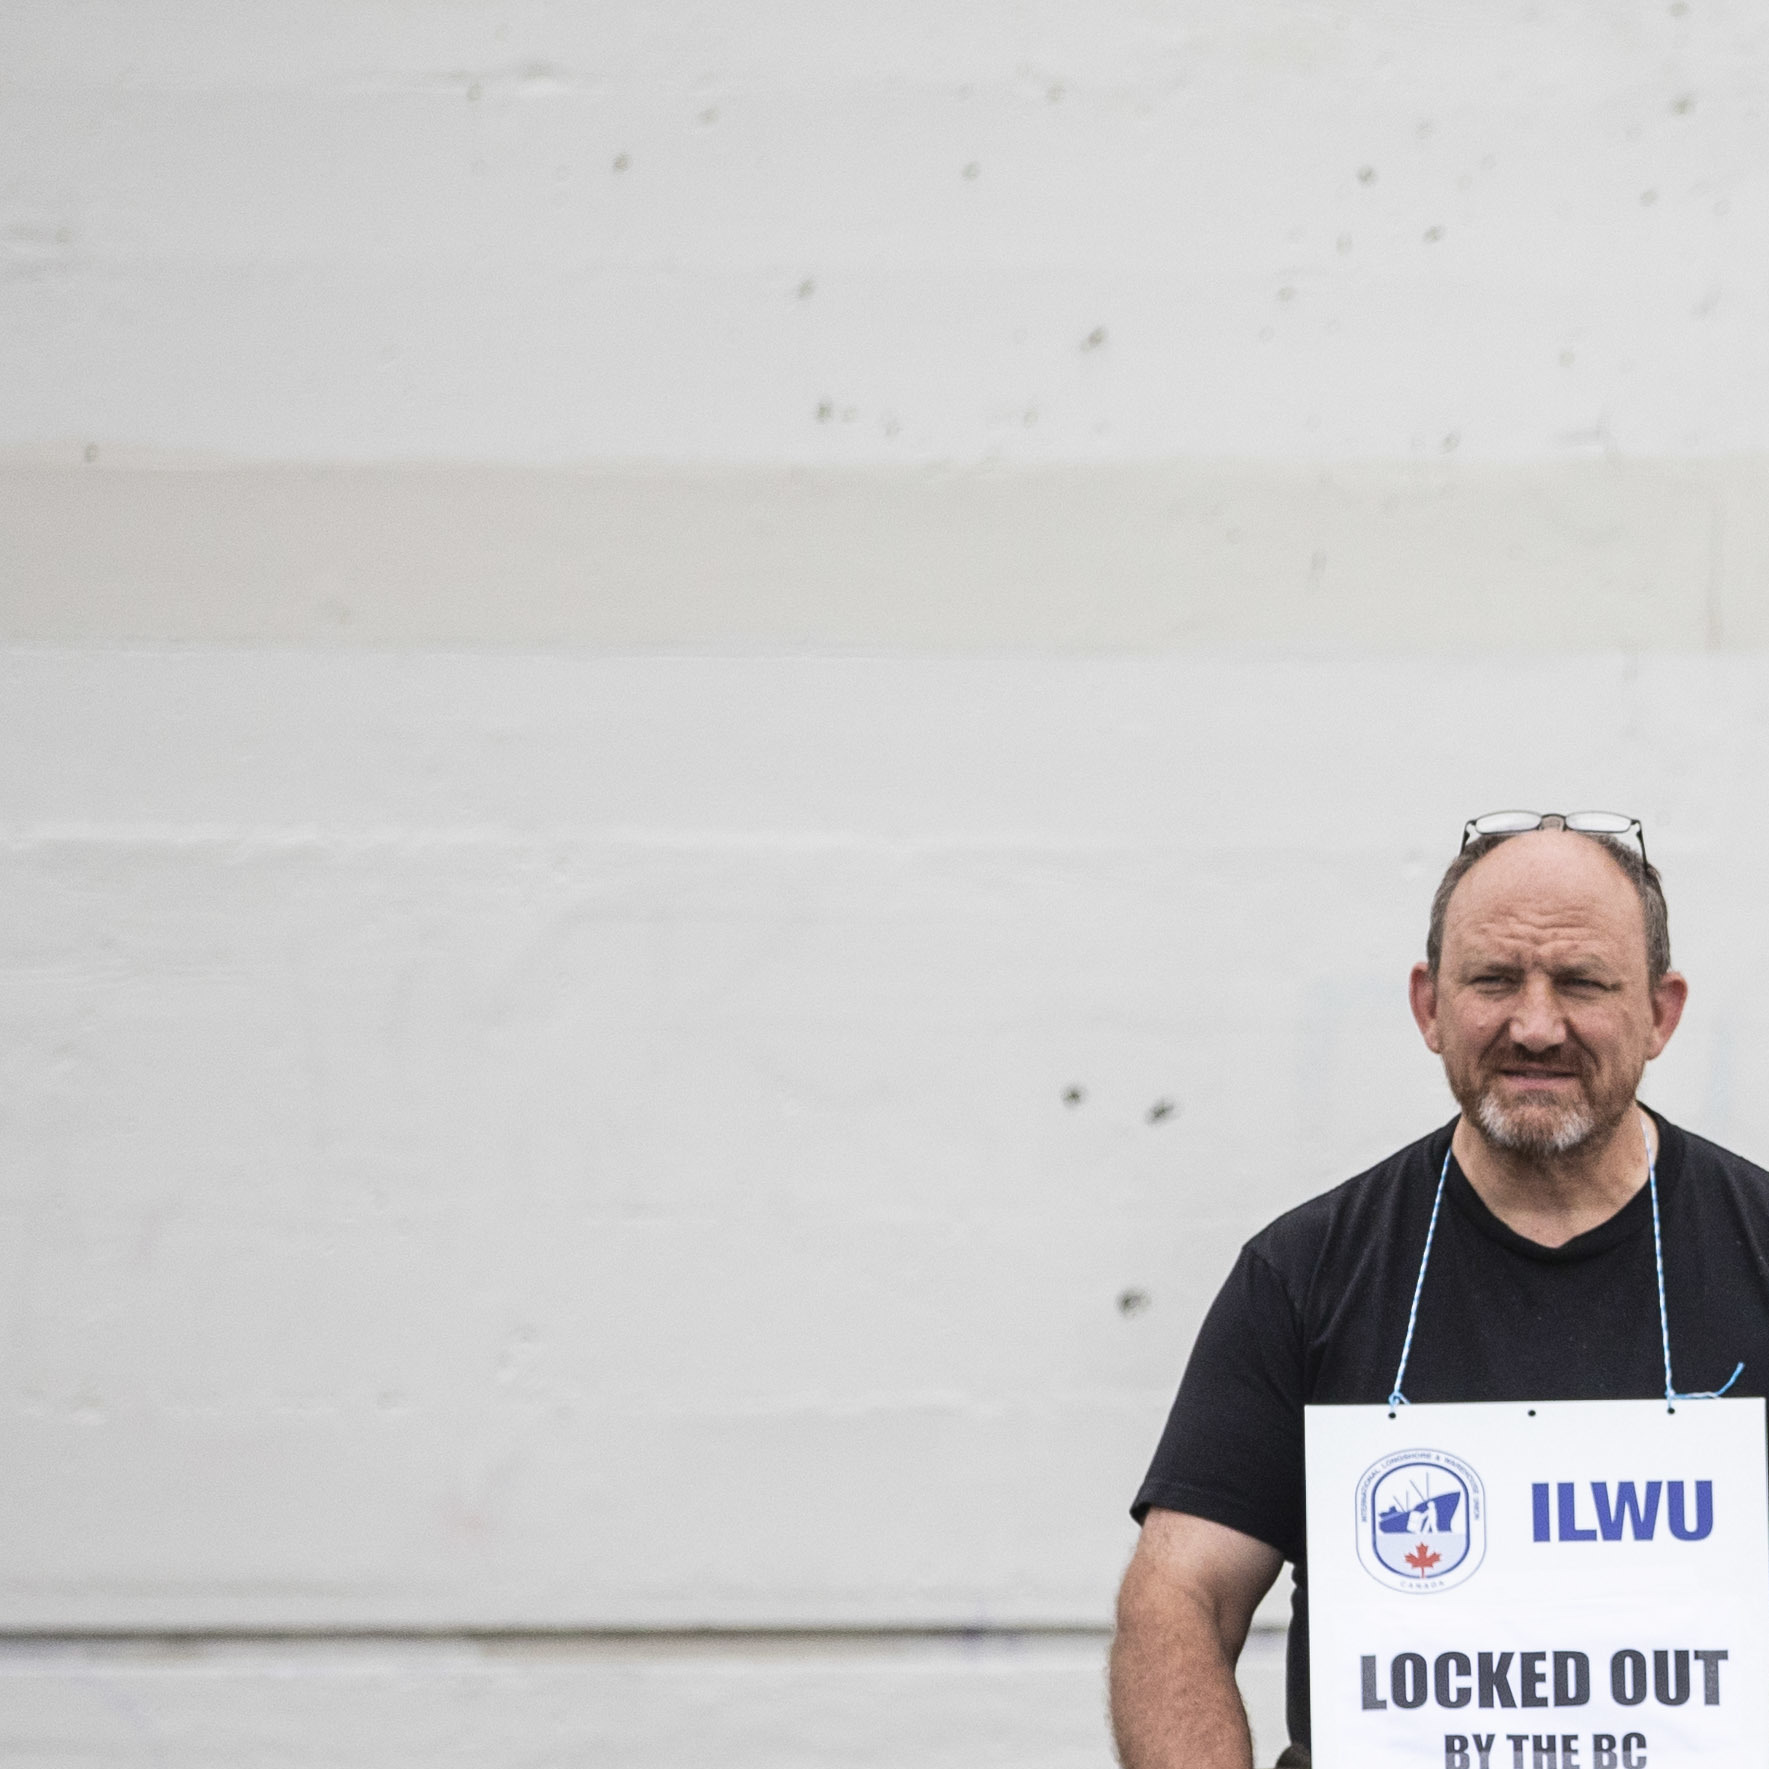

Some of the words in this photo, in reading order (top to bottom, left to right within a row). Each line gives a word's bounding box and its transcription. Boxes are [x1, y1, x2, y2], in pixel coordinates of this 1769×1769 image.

[1532, 1480, 1714, 1543] ILWU
[1361, 1650, 1591, 1710] LOCKED
[1610, 1648, 1729, 1707] OUT
